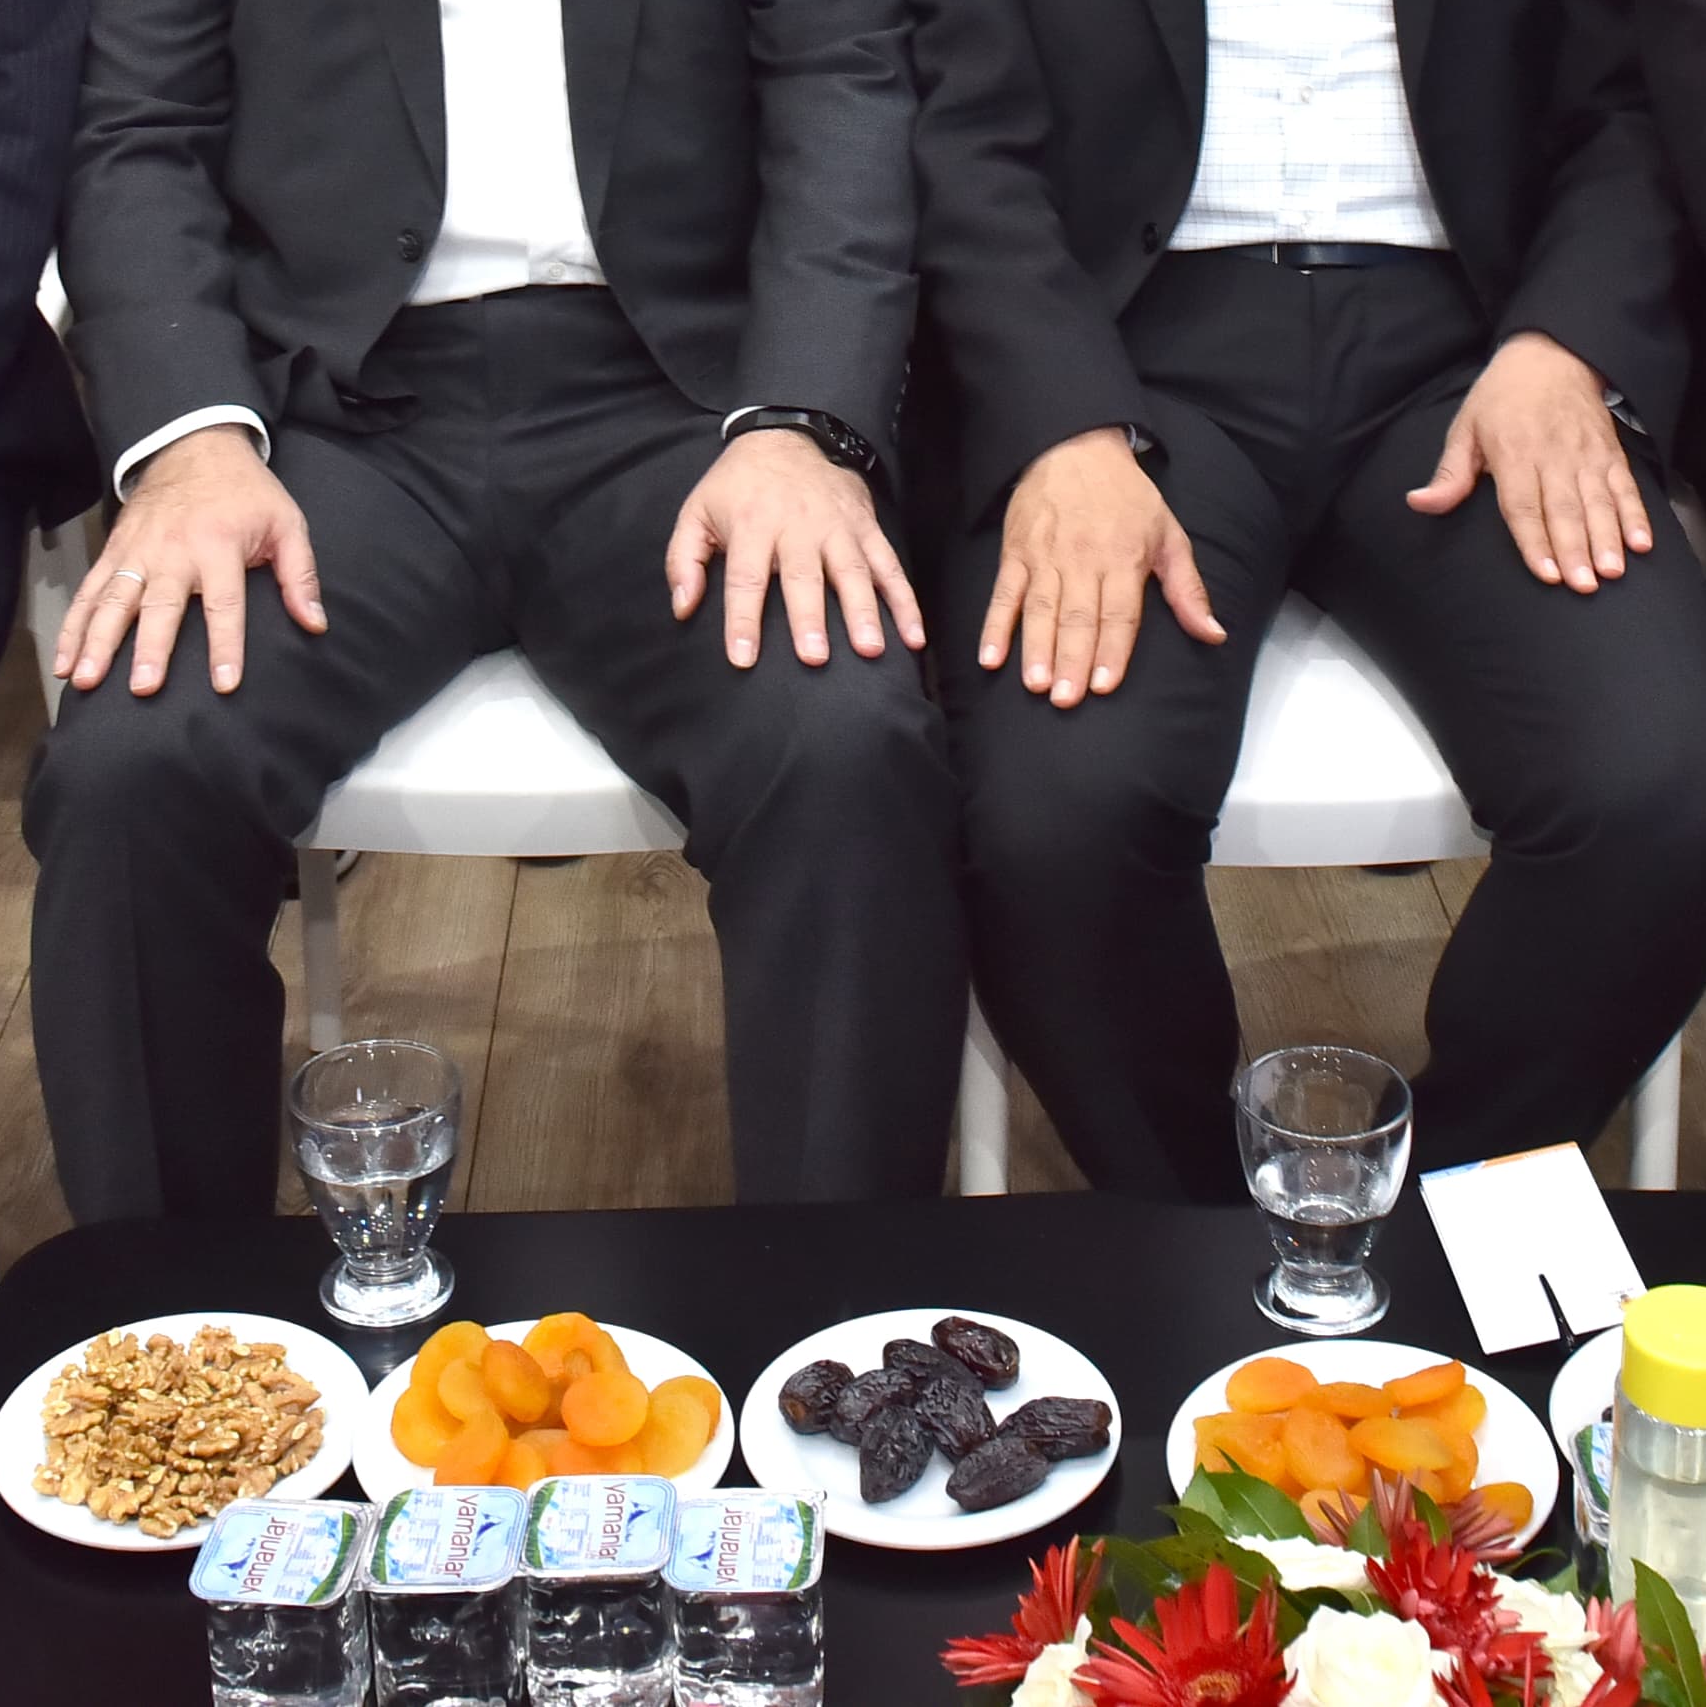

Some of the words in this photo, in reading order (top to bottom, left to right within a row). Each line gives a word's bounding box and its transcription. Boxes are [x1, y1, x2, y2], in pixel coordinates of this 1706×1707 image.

[237, 1515, 289, 1596] yamanlar
[444, 1493, 480, 1580] yamanlar
[598, 1482, 627, 1562] yamanlar
[714, 1506, 743, 1586] yamanlar
